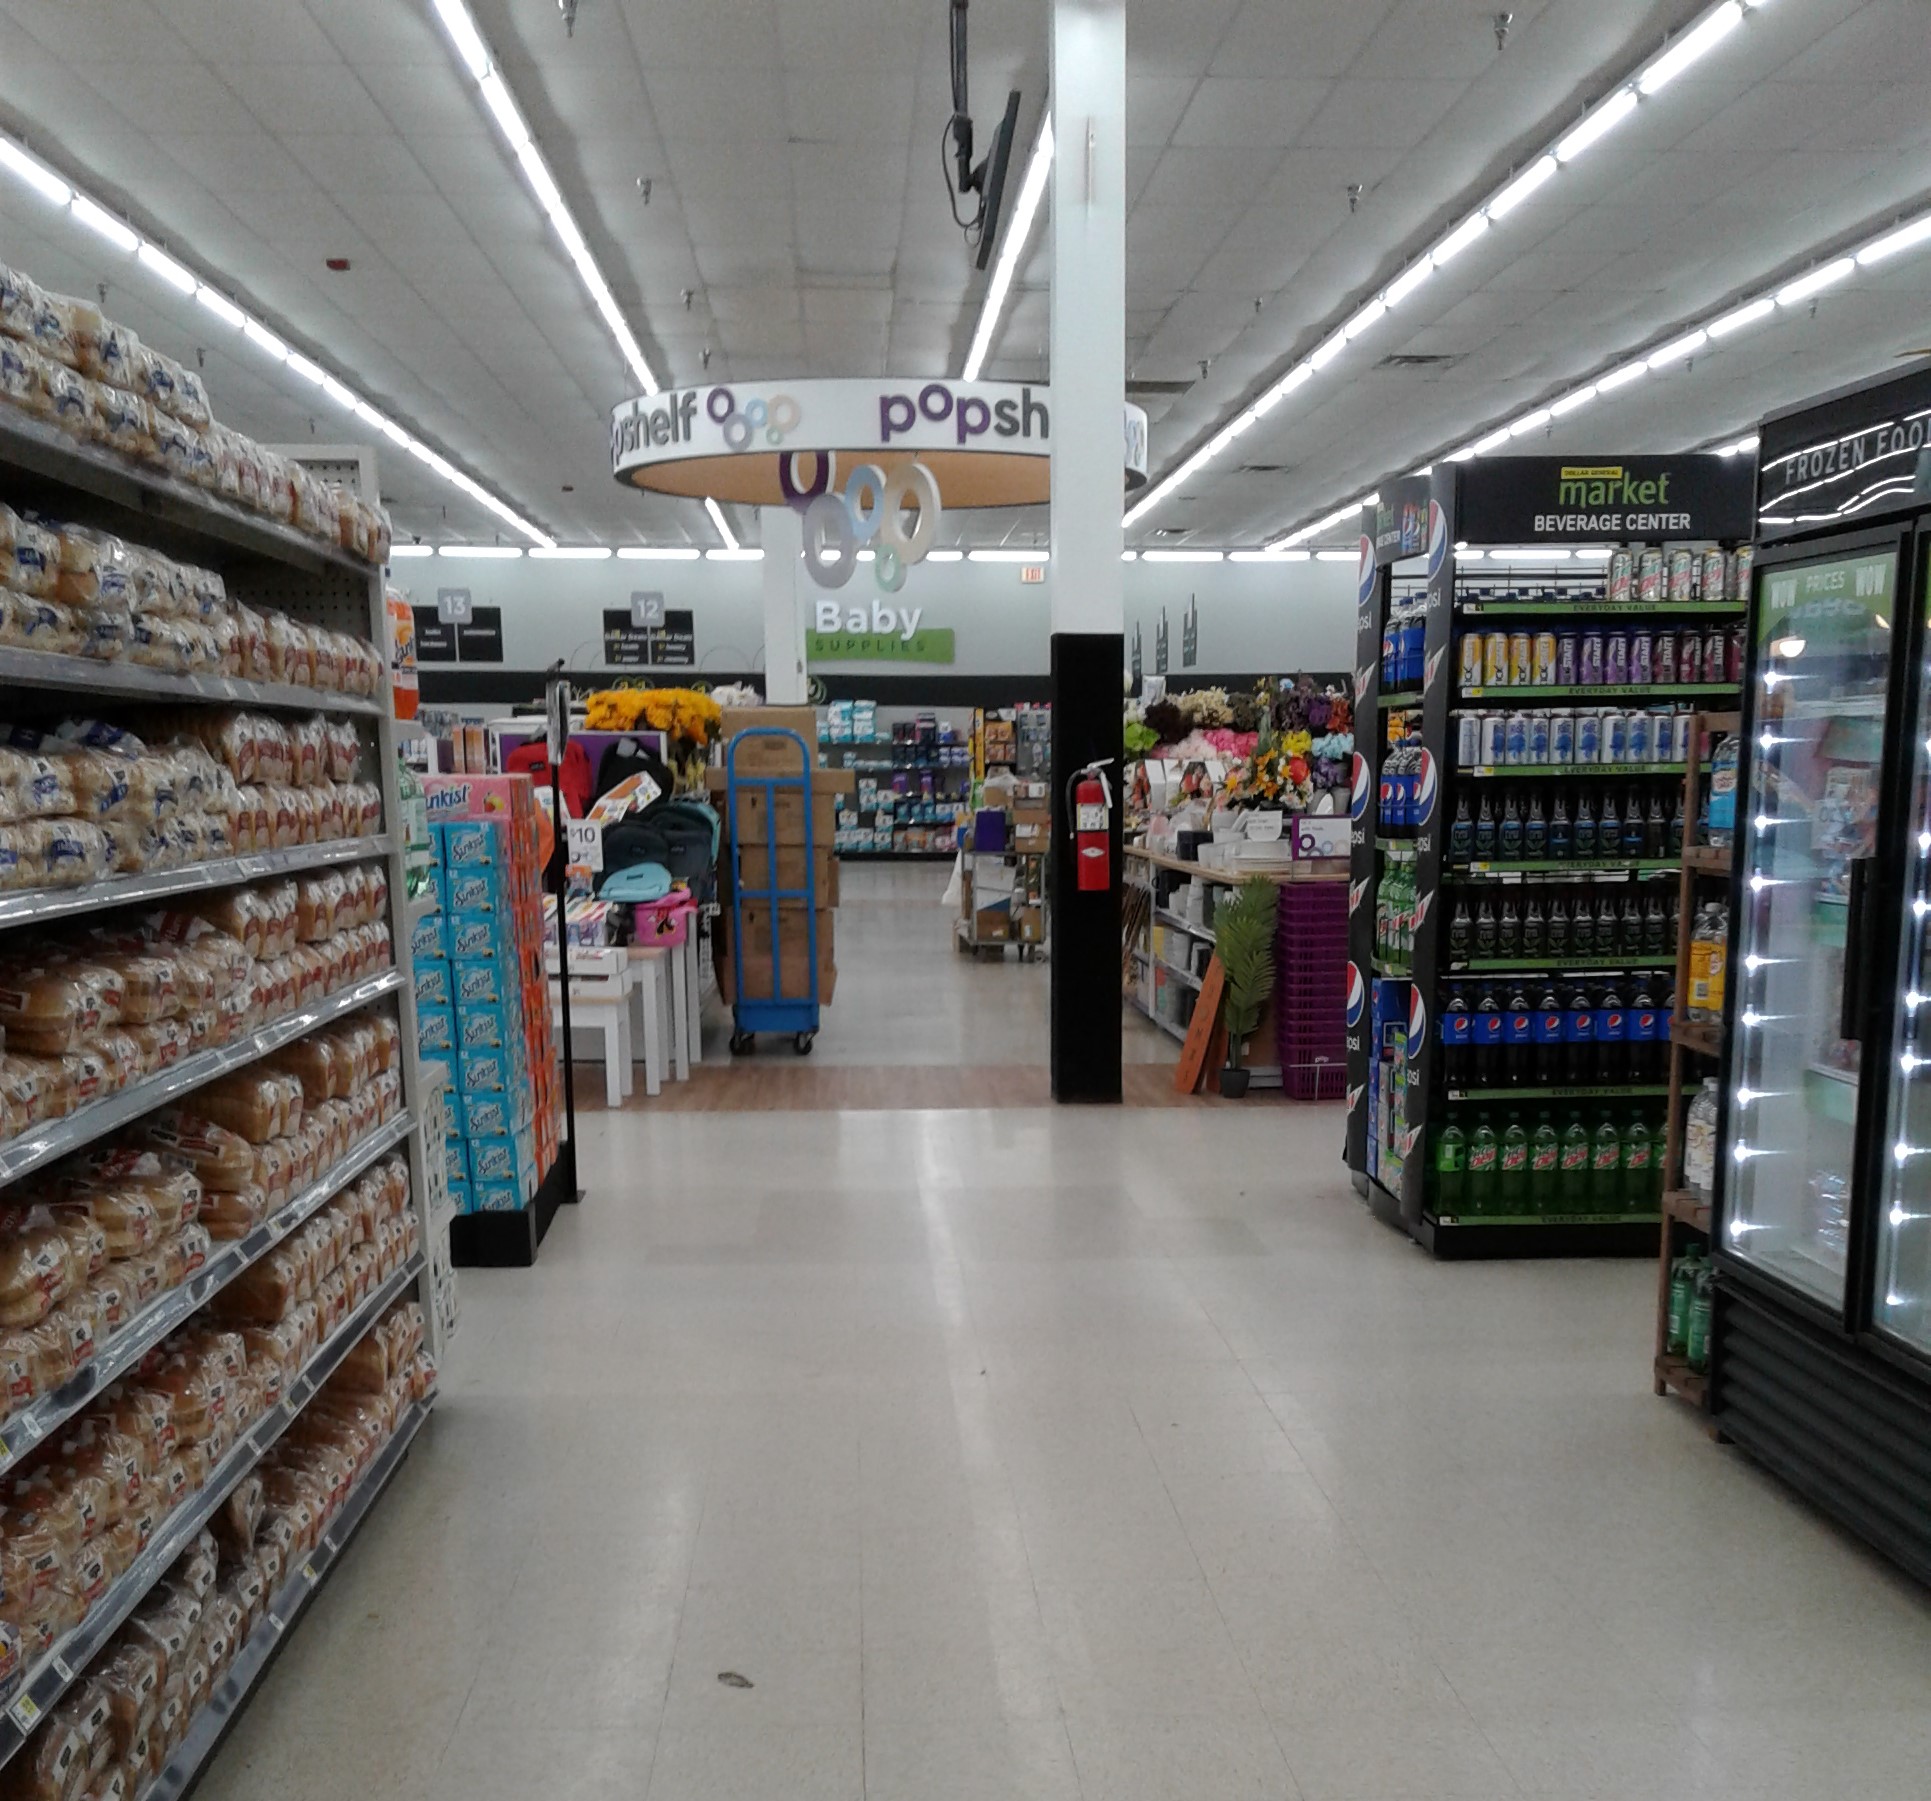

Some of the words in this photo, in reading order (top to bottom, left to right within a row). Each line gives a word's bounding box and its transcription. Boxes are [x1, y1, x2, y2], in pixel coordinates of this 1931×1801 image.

[1785, 437, 1866, 485] FROZEN
[1876, 419, 1931, 457] FOO
[1559, 471, 1672, 509] market
[1534, 514, 1621, 531] BEVERAGE
[1625, 513, 1691, 530] CENTER
[1806, 571, 1845, 592] PRICES
[1856, 564, 1887, 597] WOW
[444, 595, 466, 615] 13
[637, 599, 660, 619] 12
[815, 599, 922, 640] Baby
[815, 640, 925, 651] SUPPLIES
[570, 826, 596, 844] $10
